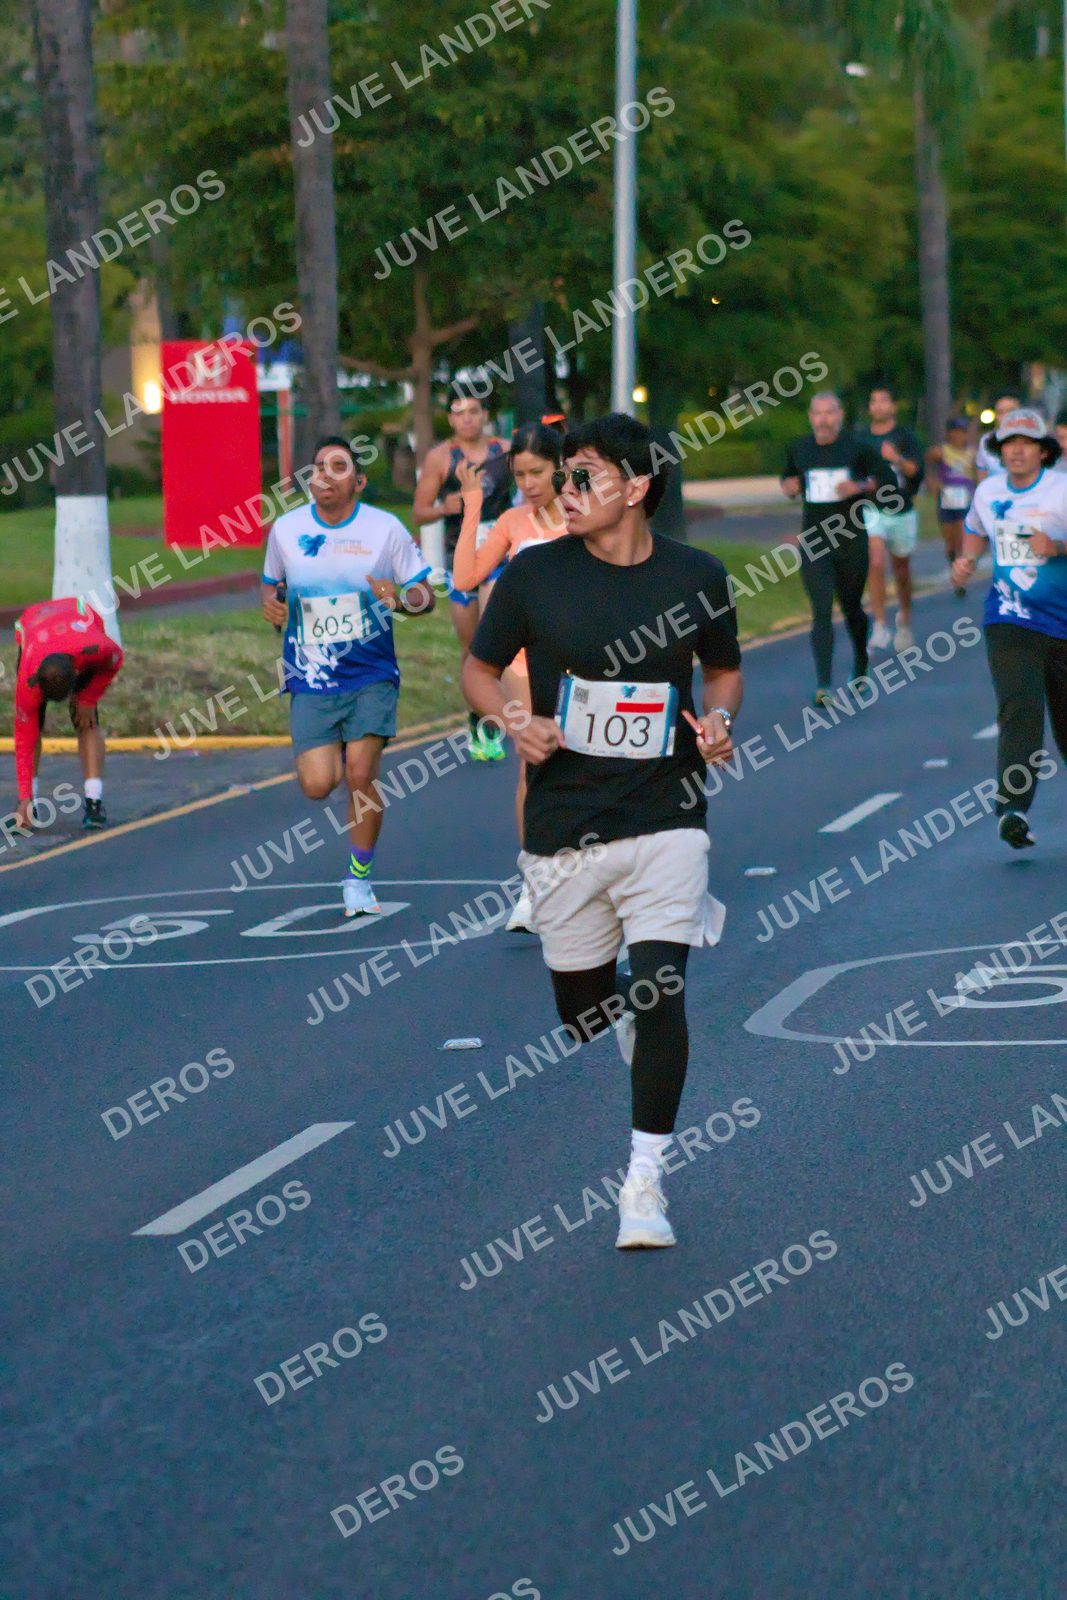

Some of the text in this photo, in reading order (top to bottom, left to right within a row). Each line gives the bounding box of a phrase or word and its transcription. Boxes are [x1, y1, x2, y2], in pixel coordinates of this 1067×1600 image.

[999, 540, 1046, 561] 182
[312, 614, 353, 638] 605
[586, 713, 650, 747] 103
